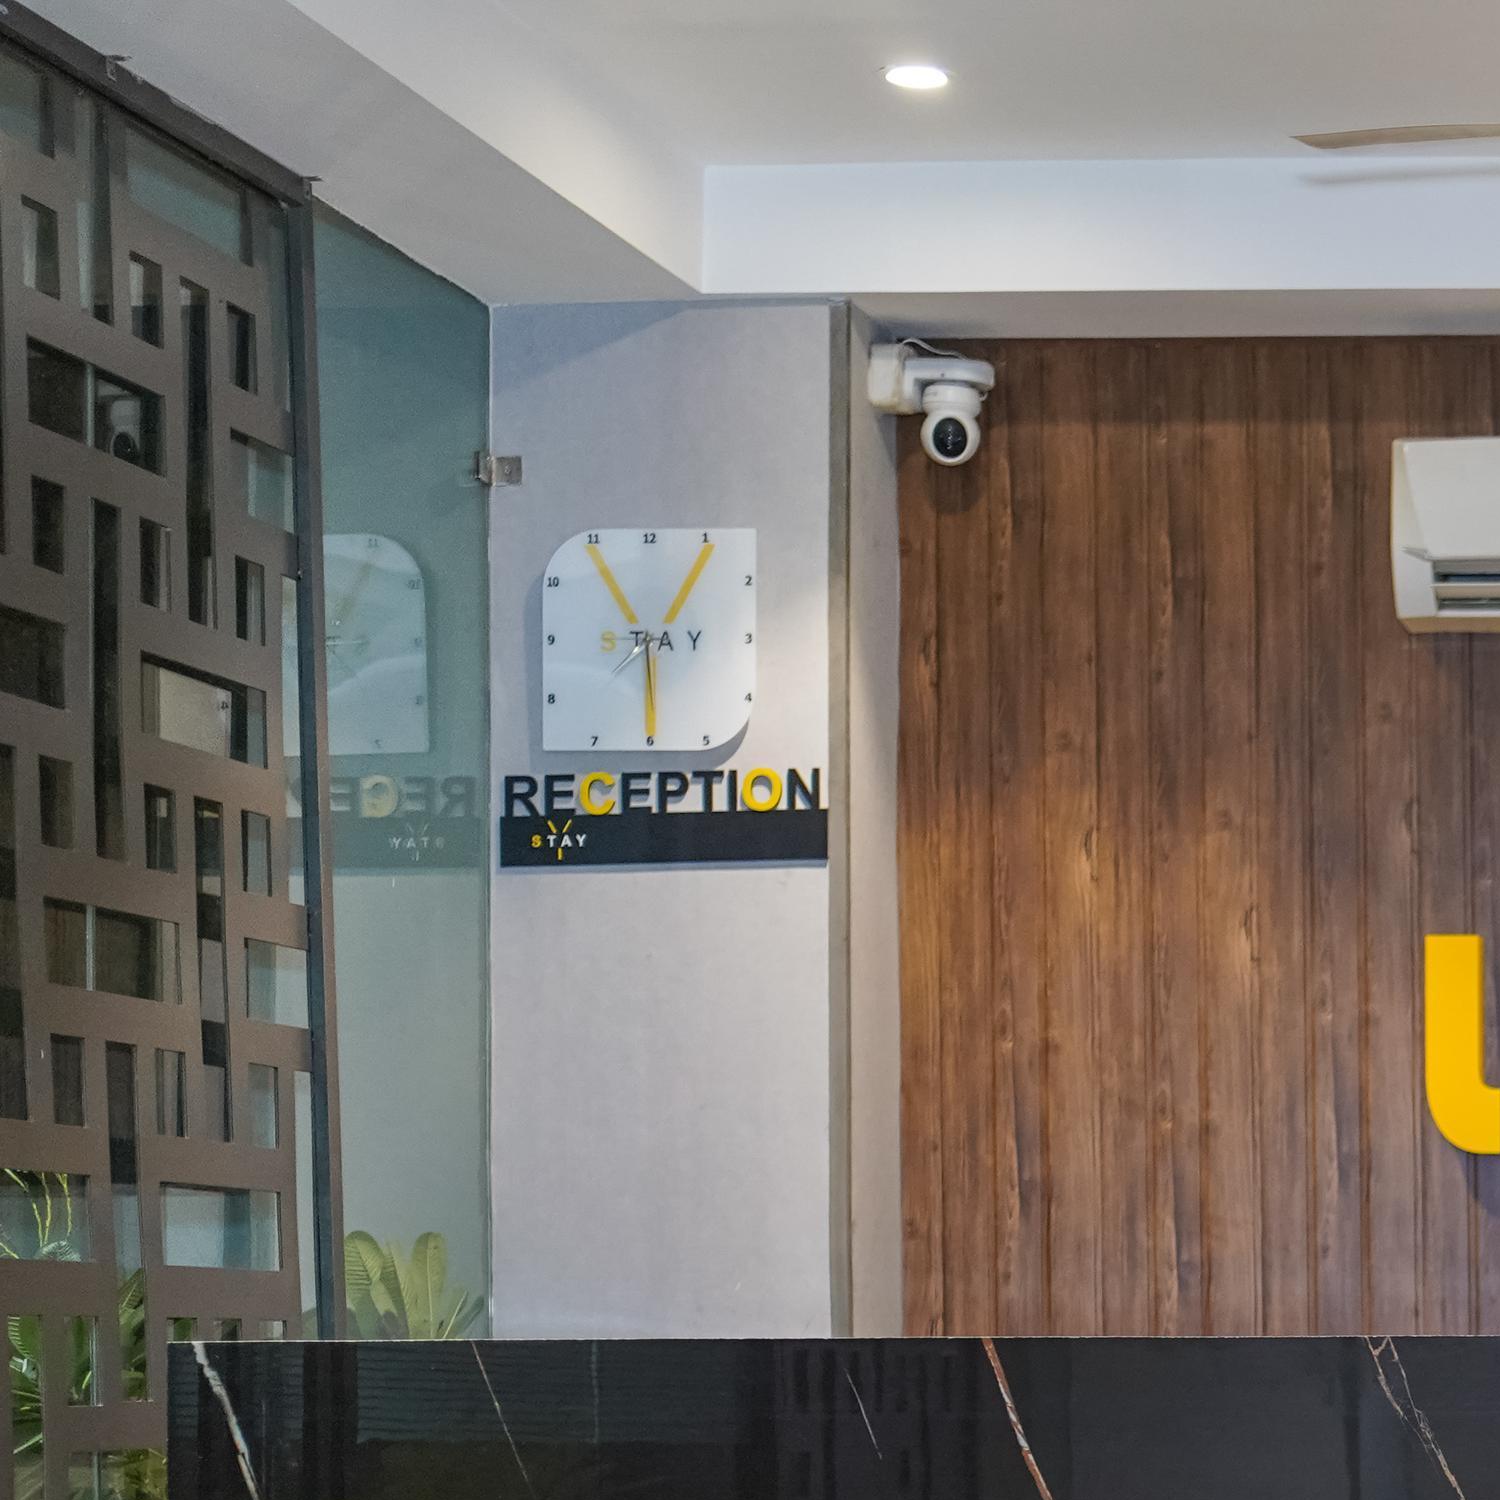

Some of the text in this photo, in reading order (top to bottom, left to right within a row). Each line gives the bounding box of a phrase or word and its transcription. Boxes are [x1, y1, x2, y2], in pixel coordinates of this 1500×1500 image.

[587, 534, 600, 544] 11
[643, 534, 656, 543] 12
[702, 533, 708, 543] 1
[547, 577, 559, 587] 10
[745, 576, 751, 586] 2
[548, 635, 555, 645] 9
[601, 630, 701, 652] STAY
[745, 634, 752, 644] 3
[548, 694, 555, 704] 8
[745, 693, 752, 702] 4
[591, 737, 597, 746] 7
[647, 736, 654, 746] 6
[703, 736, 709, 746] 5
[504, 768, 820, 817] RECEPTION
[532, 833, 586, 847] STAY
